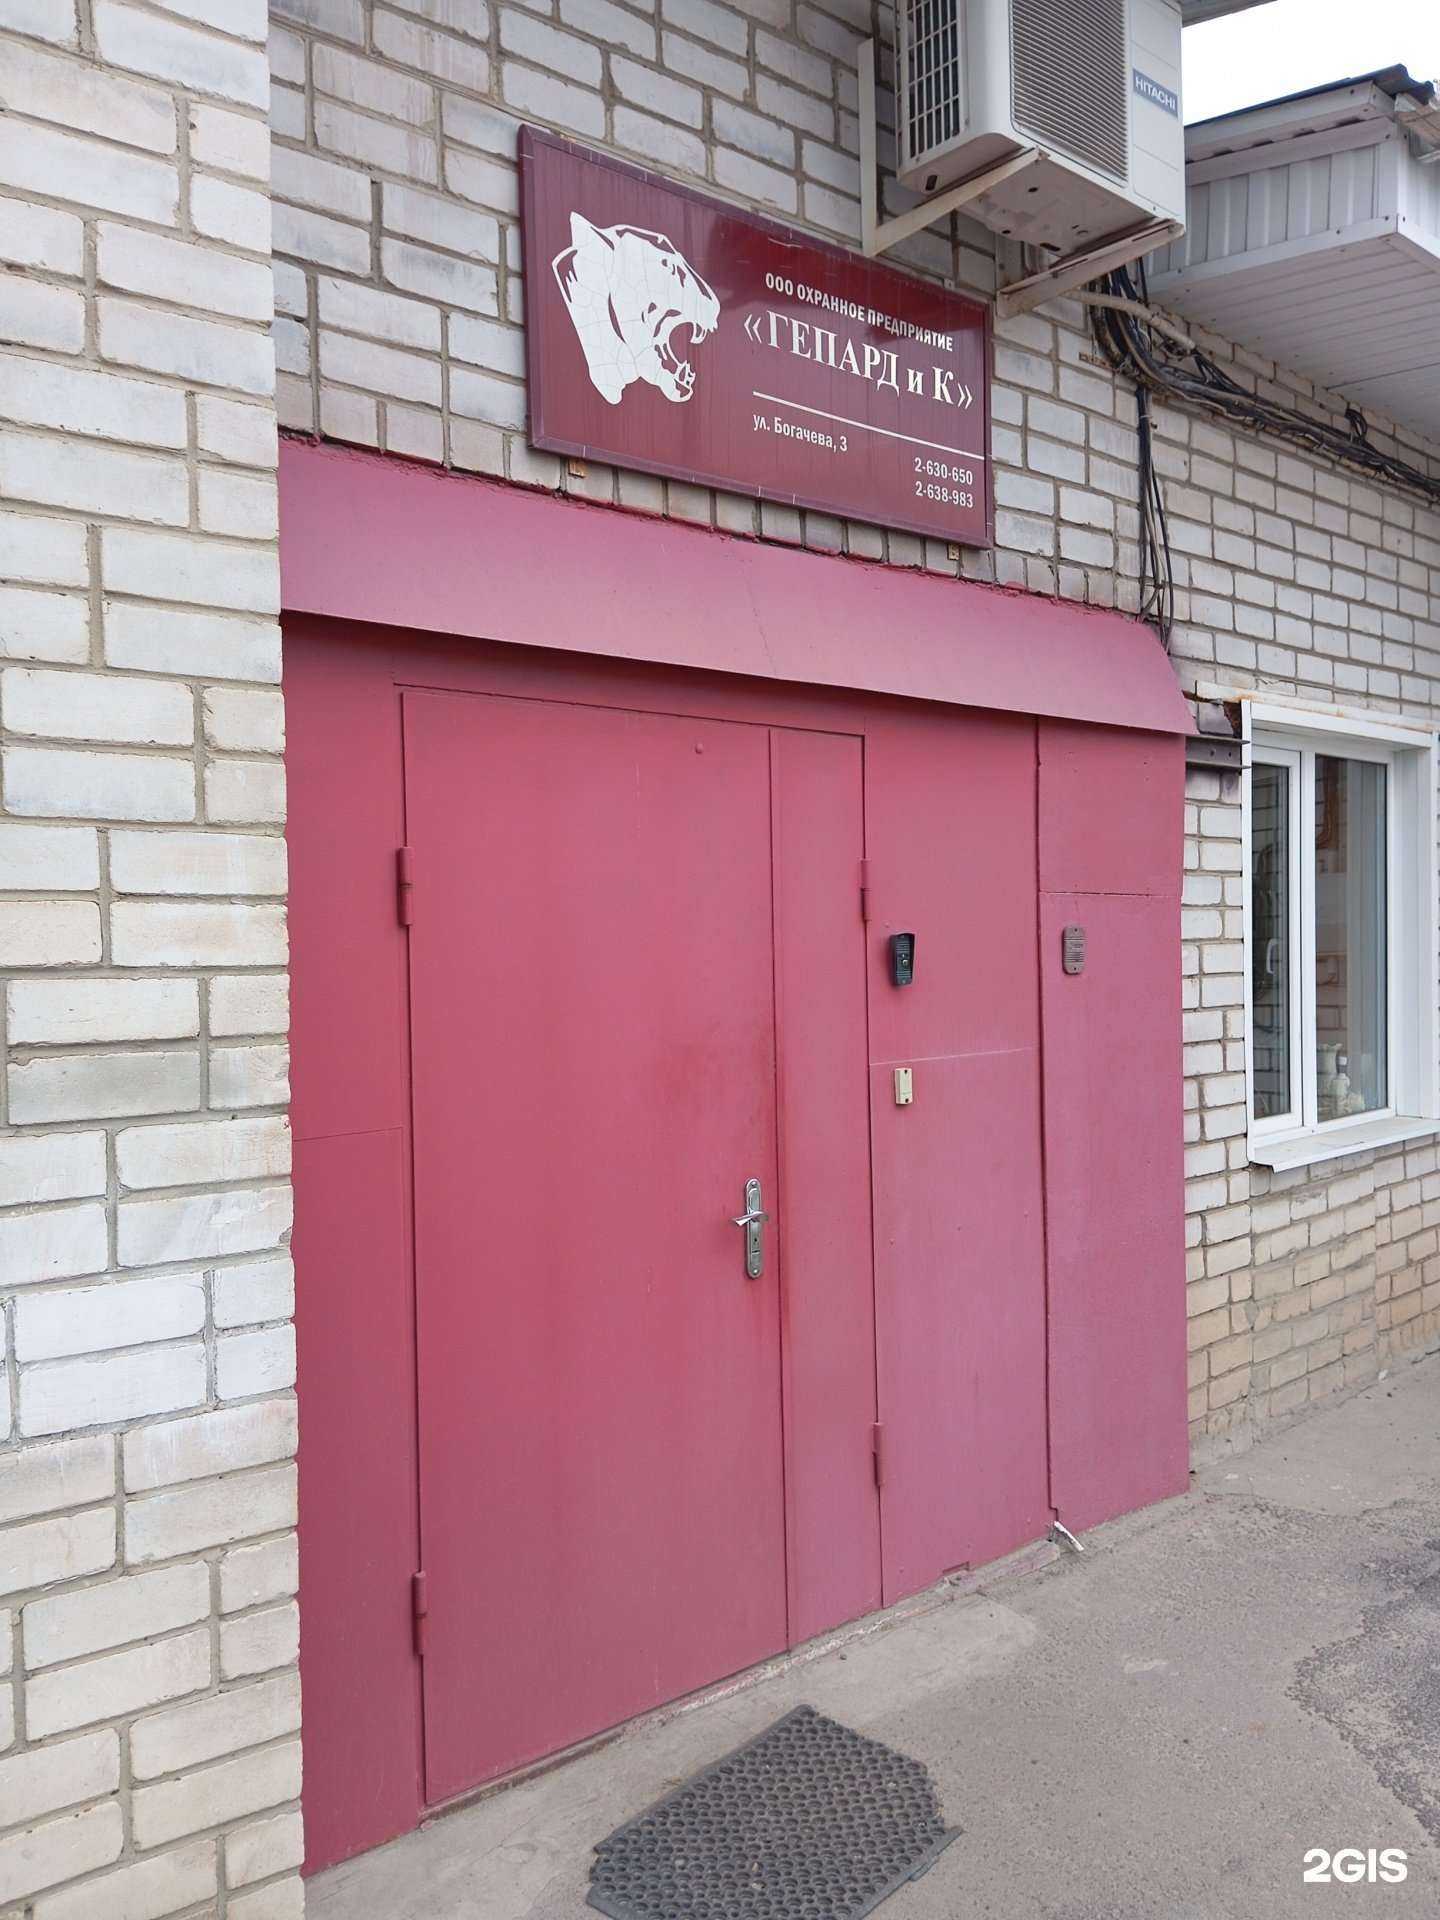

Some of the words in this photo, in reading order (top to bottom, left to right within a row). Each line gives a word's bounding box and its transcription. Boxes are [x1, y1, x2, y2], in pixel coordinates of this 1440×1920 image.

[1136, 76, 1176, 111] HITACHI
[766, 273, 793, 296] ООО
[797, 284, 865, 321] ОХРАННОЕ
[867, 308, 953, 352] ПРЕДПРИЯТИЕ
[744, 310, 900, 397] «ГЕПАРД
[907, 368, 924, 395] и
[932, 366, 973, 410] К»
[753, 414, 770, 431] ул.
[774, 416, 837, 452] Богачева,
[839, 436, 848, 452] 3
[914, 457, 973, 485] 2-630-650
[915, 481, 974, 508] 2-638-983
